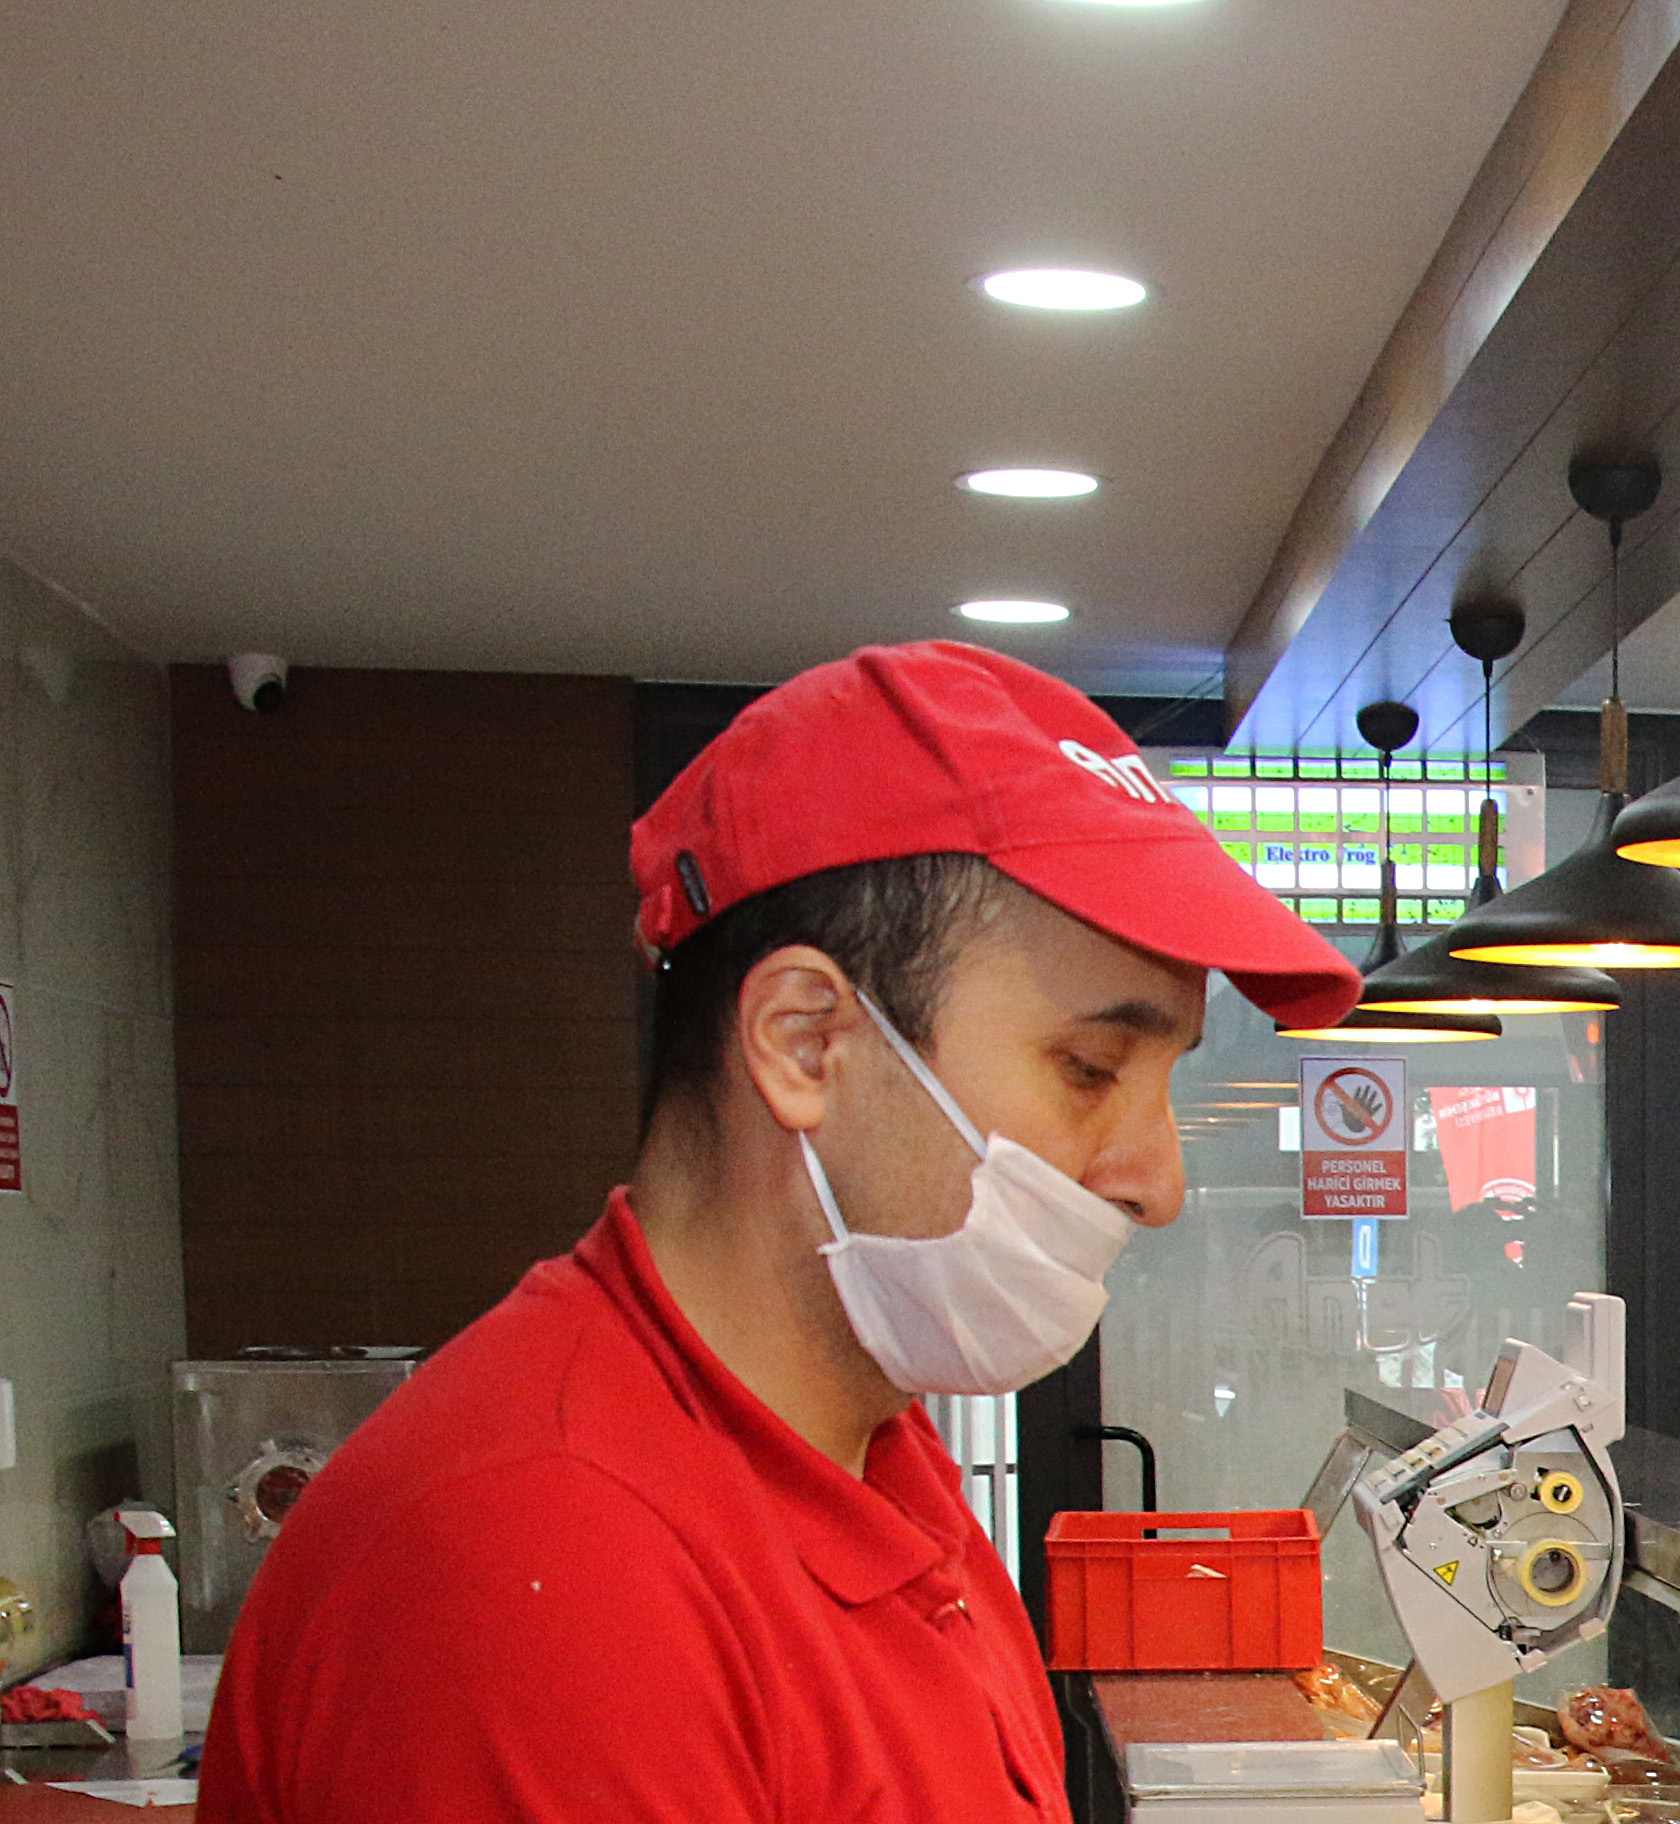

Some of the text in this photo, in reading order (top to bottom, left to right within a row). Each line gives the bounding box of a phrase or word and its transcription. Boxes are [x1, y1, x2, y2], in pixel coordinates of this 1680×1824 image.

[1266, 845, 1376, 865] Eletro rog
[1321, 1160, 1386, 1174] PERSONEL
[1307, 1175, 1401, 1190] HARİCİ GİRMEK
[1324, 1194, 1386, 1208] YASAKTIR
